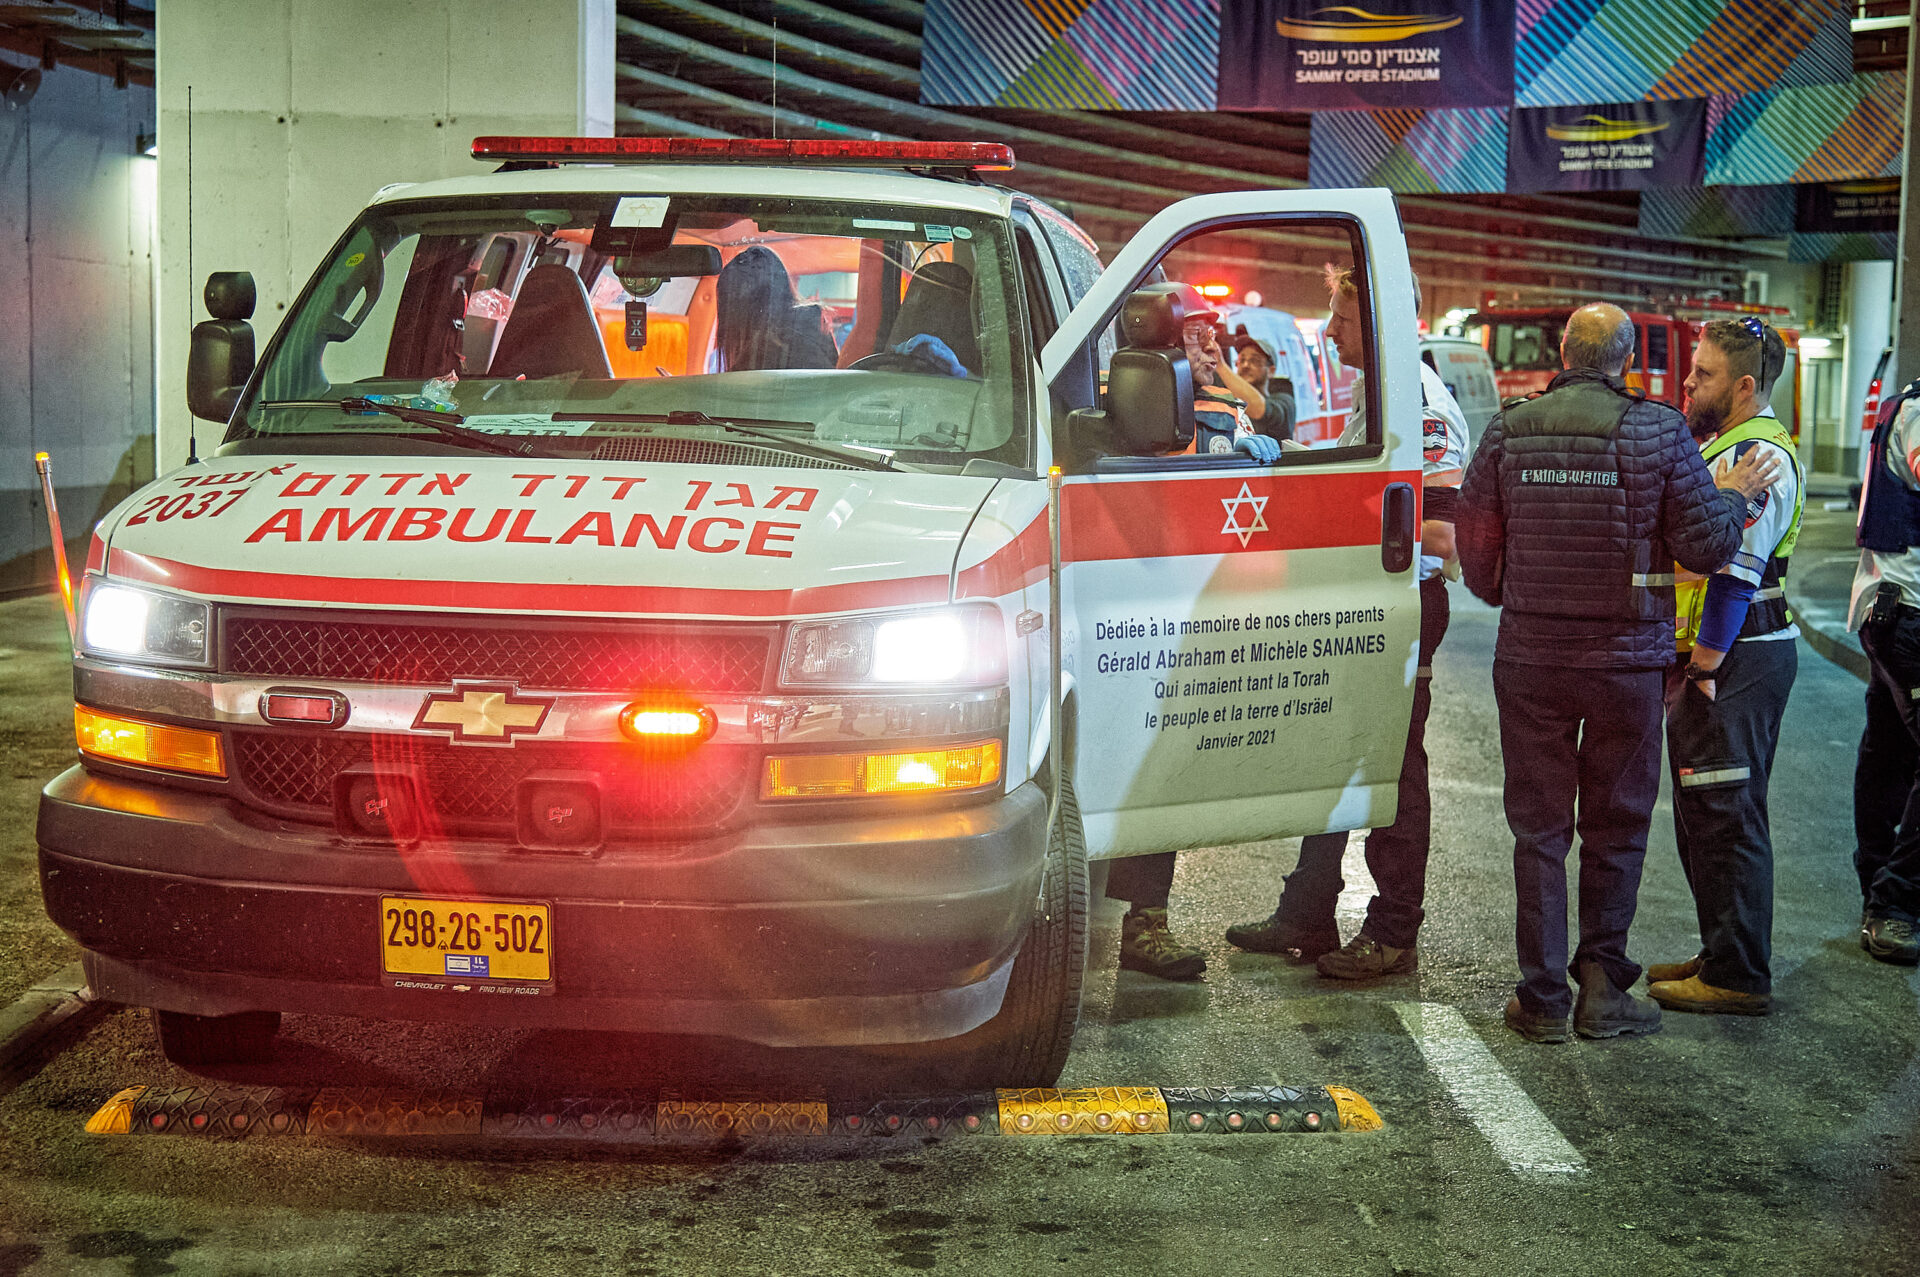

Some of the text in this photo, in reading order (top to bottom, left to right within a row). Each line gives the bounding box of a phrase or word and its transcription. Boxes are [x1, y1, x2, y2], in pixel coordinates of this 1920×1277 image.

[1296, 48, 1440, 68] אצטדיון סמי עופר
[1295, 68, 1440, 83] SAMMY OFER STADIUM
[124, 486, 251, 527] 2037
[278, 471, 820, 512] מגן דוד אדום
[243, 507, 802, 559] AMBULANCE
[1095, 606, 1385, 641] Dédiée à la memoire de nos chers parents
[1097, 633, 1386, 674] Gérald Abraham et Michèle SANANES
[1154, 669, 1330, 699] Qui aimaient tant la Torah
[1145, 712, 1157, 729] le
[1161, 708, 1209, 732] peuple
[1213, 707, 1226, 723] et
[1230, 705, 1243, 722] la
[1247, 701, 1279, 720] terre
[1196, 729, 1276, 751] Janvier 2021
[395, 981, 446, 990] CHEVROLET
